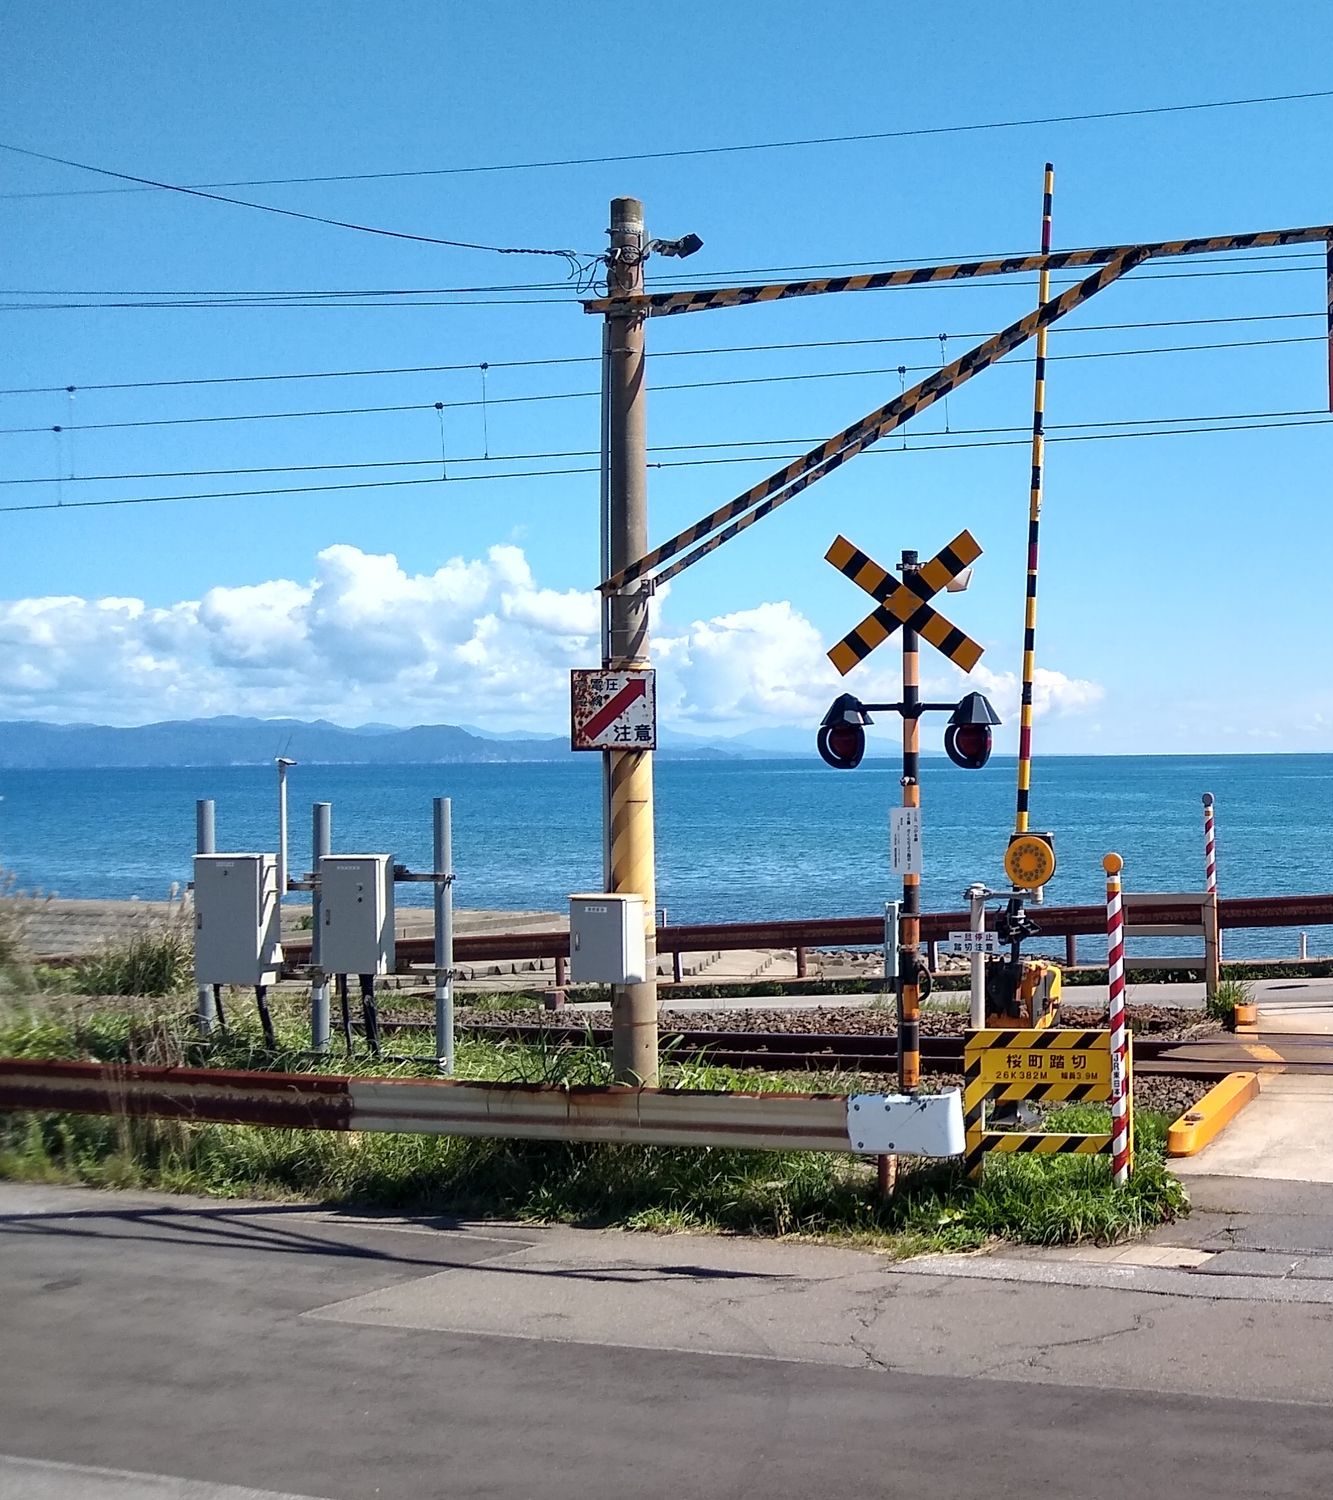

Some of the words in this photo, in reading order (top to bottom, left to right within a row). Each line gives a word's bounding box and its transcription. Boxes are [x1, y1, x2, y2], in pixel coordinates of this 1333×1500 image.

[613, 723, 652, 742] 注意
[953, 933, 994, 942] 一旦停止
[953, 943, 994, 952] 踏切注意
[1006, 1053, 1087, 1069] 桜町踏切
[995, 1071, 1048, 1080] 26K382M
[1113, 1053, 1121, 1096] JR東日本
